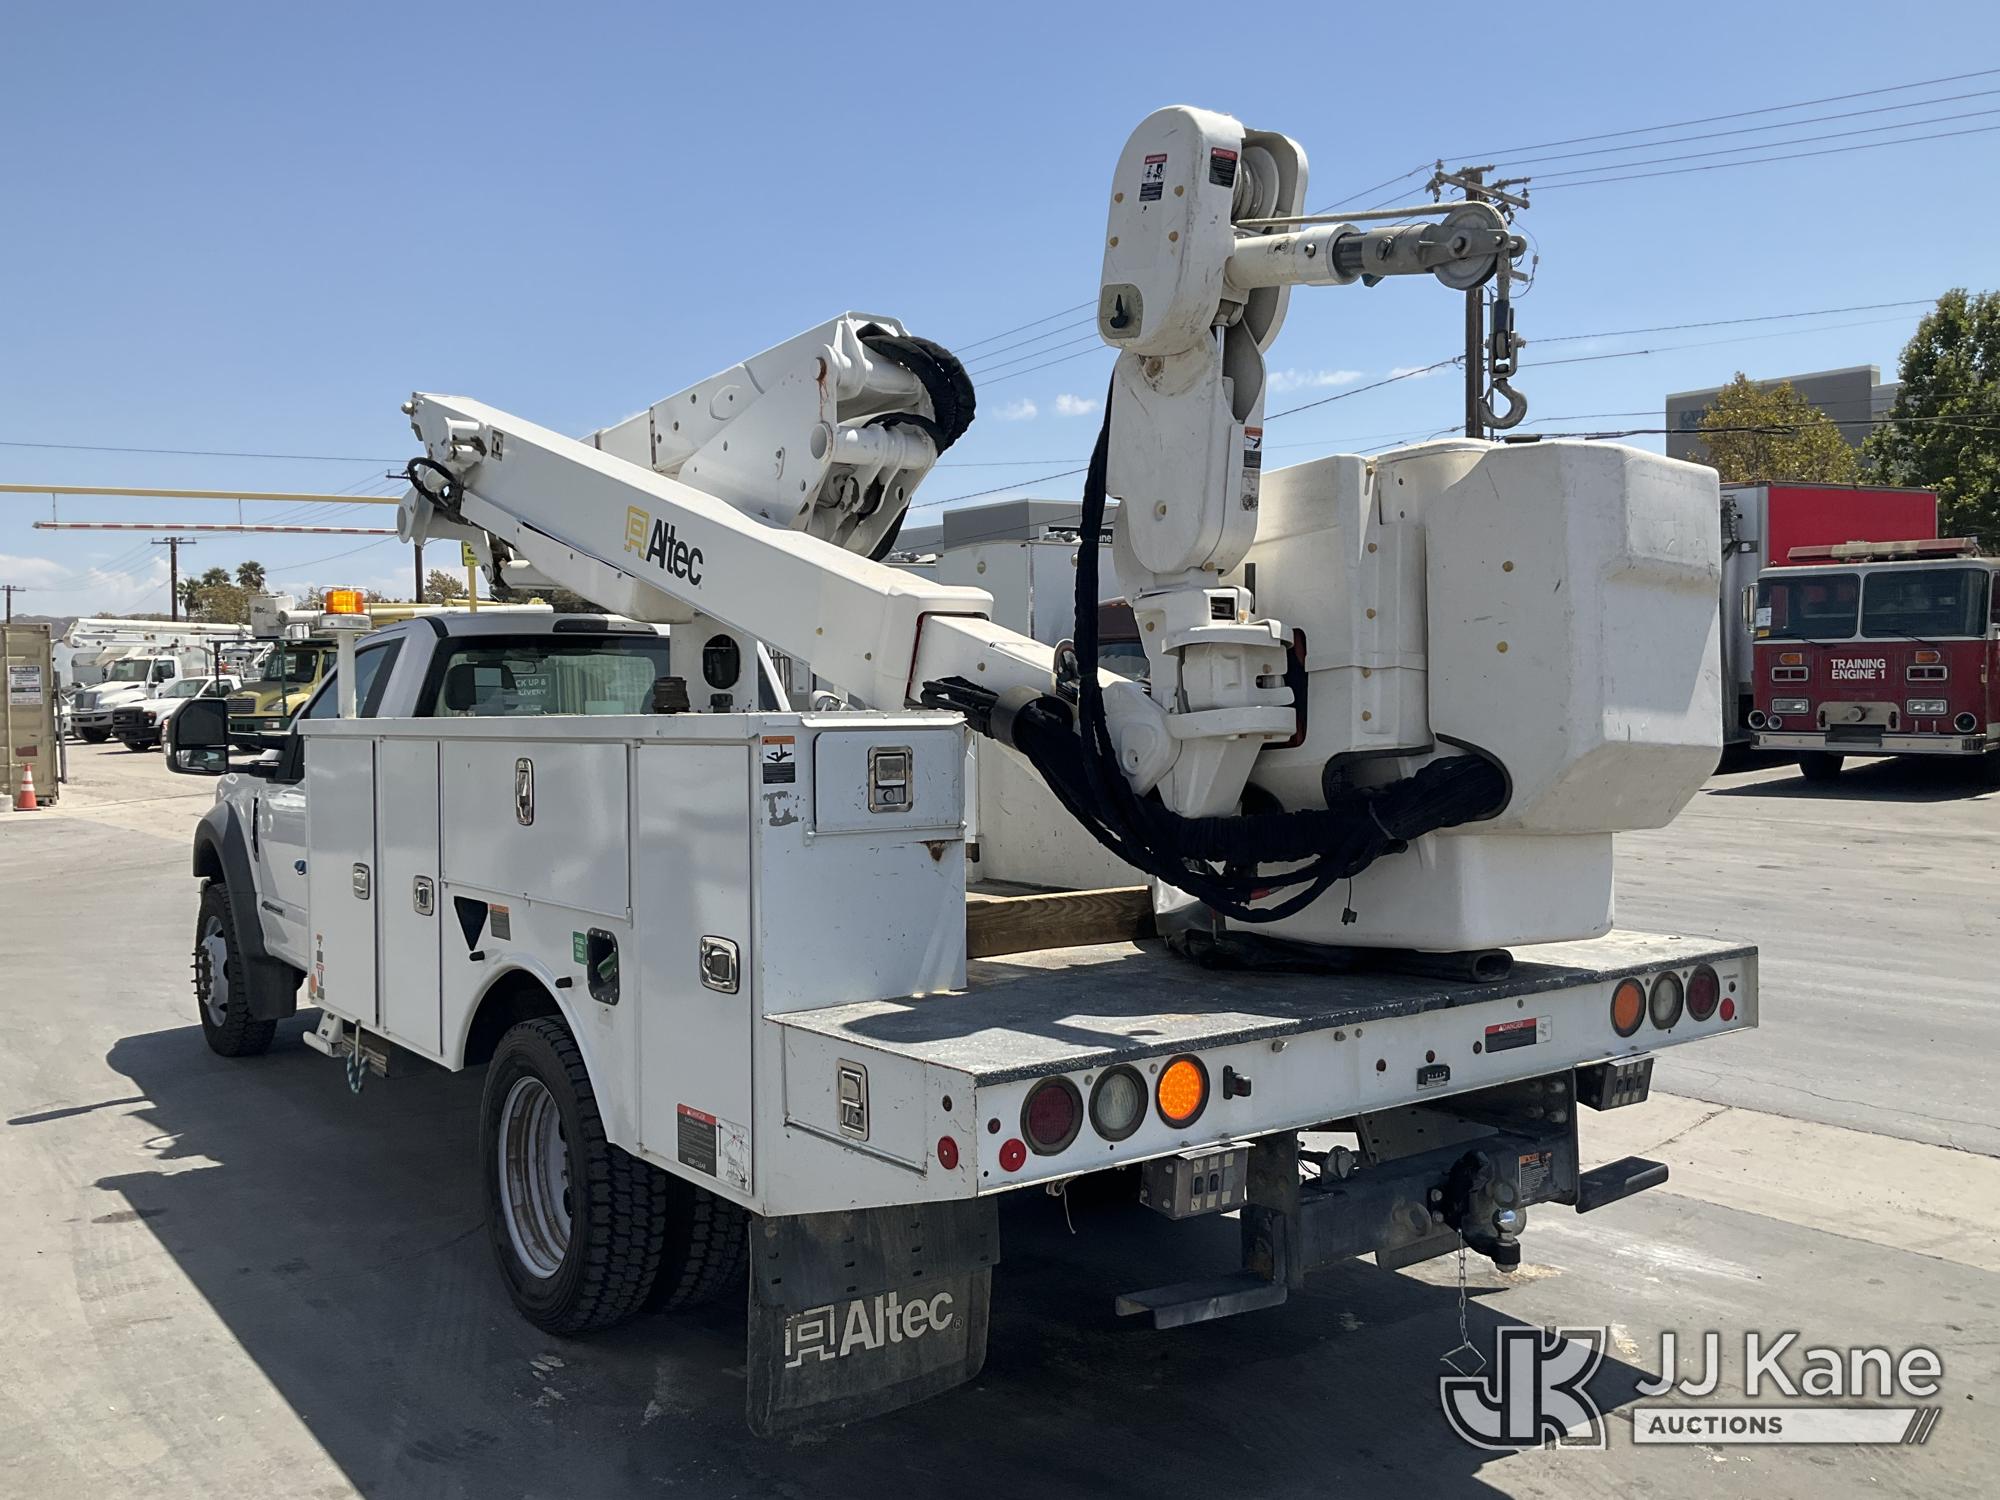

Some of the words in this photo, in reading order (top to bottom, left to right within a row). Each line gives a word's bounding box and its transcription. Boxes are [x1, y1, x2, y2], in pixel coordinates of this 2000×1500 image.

[646, 518, 703, 586] Altec
[1830, 658, 1886, 669] TRAINING
[1831, 669, 1876, 680] ENGINE
[1880, 669, 1886, 680] 1
[515, 680, 527, 688] CK
[840, 1291, 953, 1357] Altec
